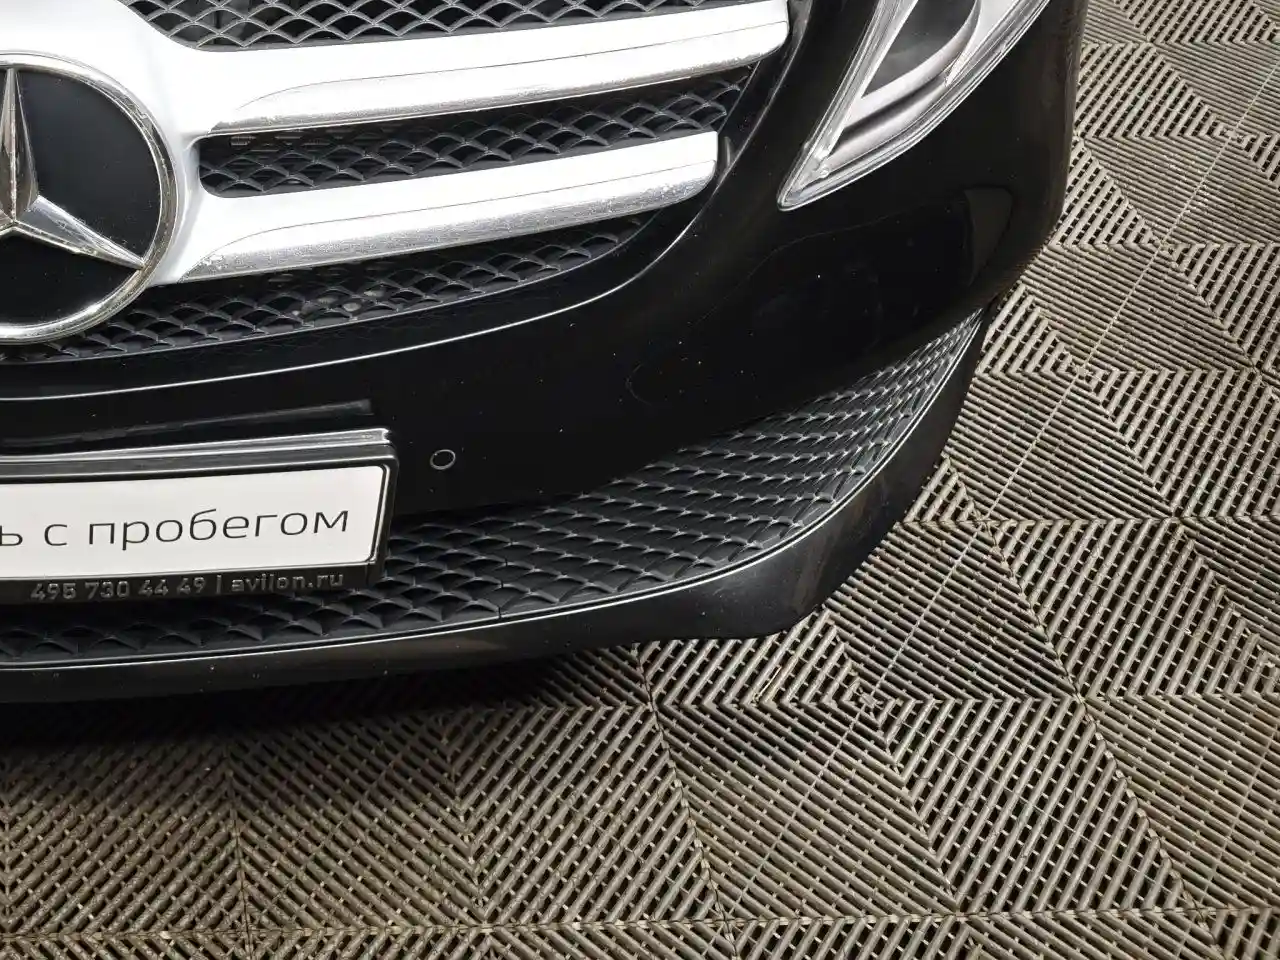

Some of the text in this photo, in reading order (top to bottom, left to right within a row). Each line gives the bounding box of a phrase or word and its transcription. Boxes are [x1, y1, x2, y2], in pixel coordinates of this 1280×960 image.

[45, 524, 67, 546] с
[89, 509, 348, 550] пробегом
[30, 582, 77, 601] 495
[84, 579, 131, 600] 730
[138, 578, 169, 597] 44
[176, 576, 207, 595] 49
[231, 572, 345, 592] avilon.ru
